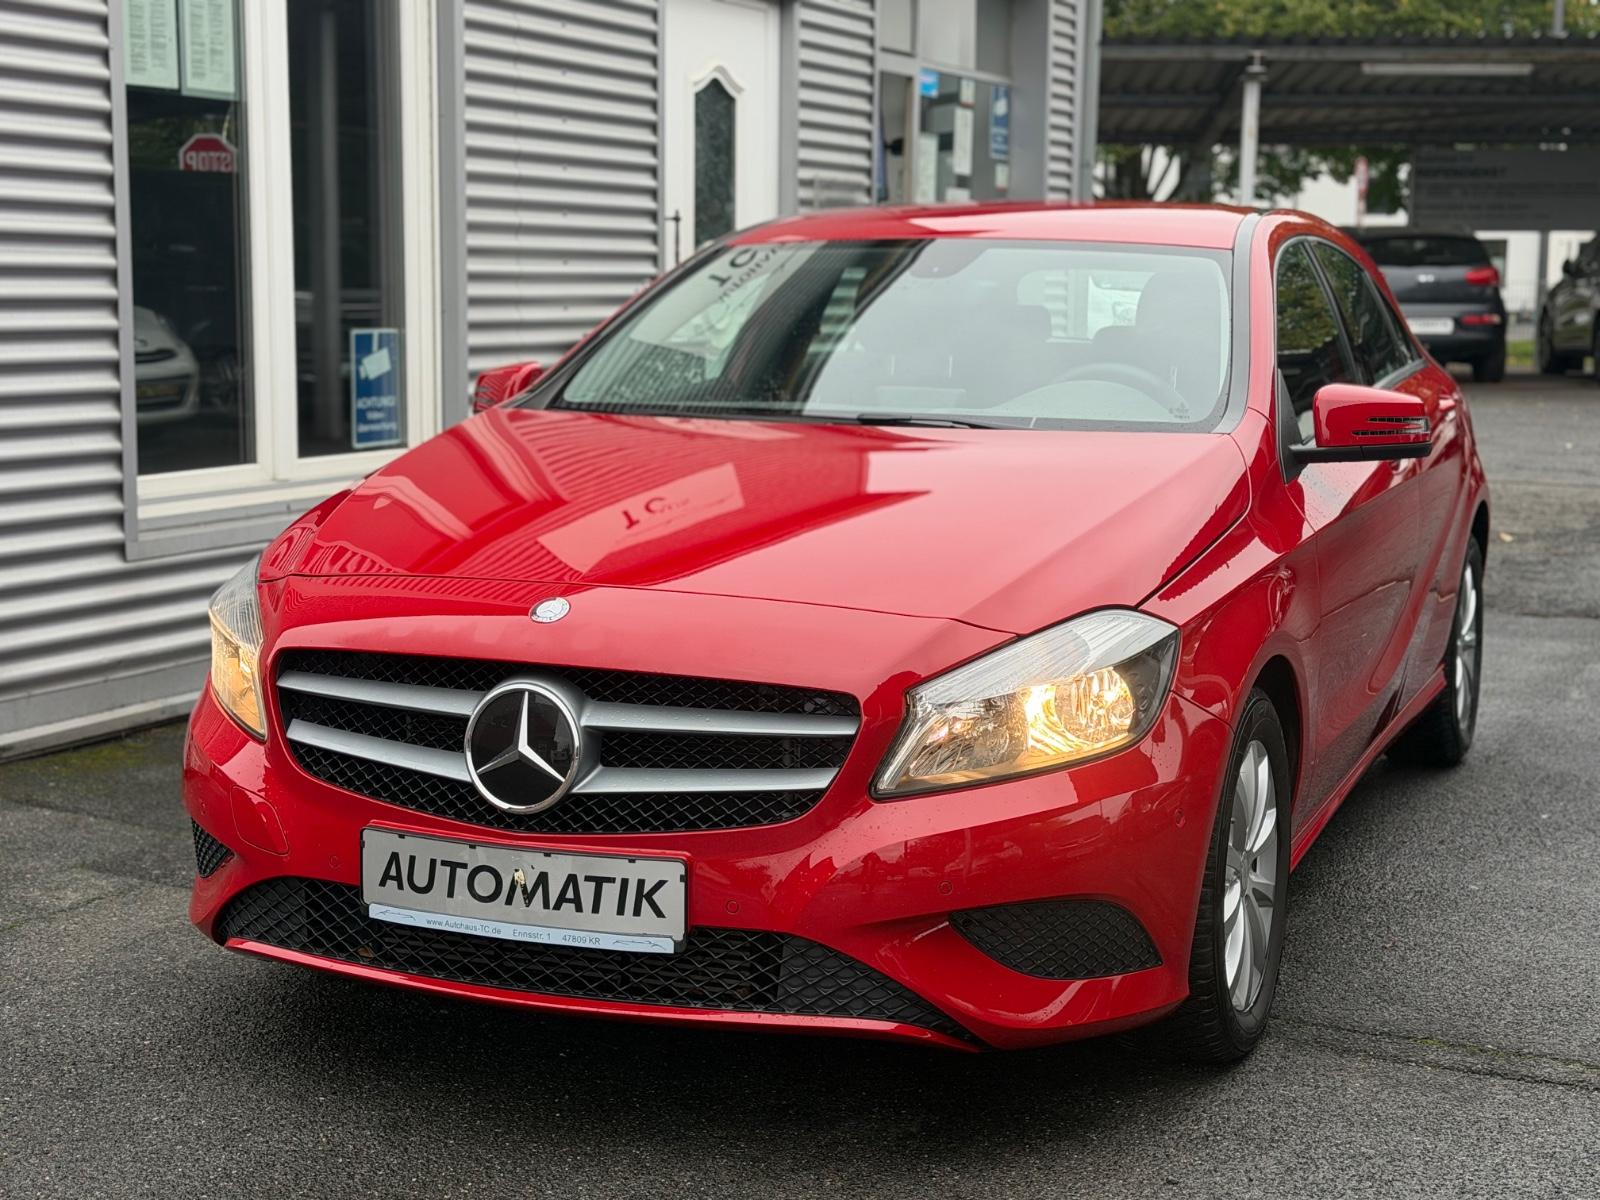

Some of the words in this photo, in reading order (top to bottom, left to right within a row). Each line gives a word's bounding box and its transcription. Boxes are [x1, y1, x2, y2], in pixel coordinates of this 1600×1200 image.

[378, 851, 669, 919] AUTOMATIK
[561, 934, 587, 944] 47809
[588, 936, 601, 946] KR
